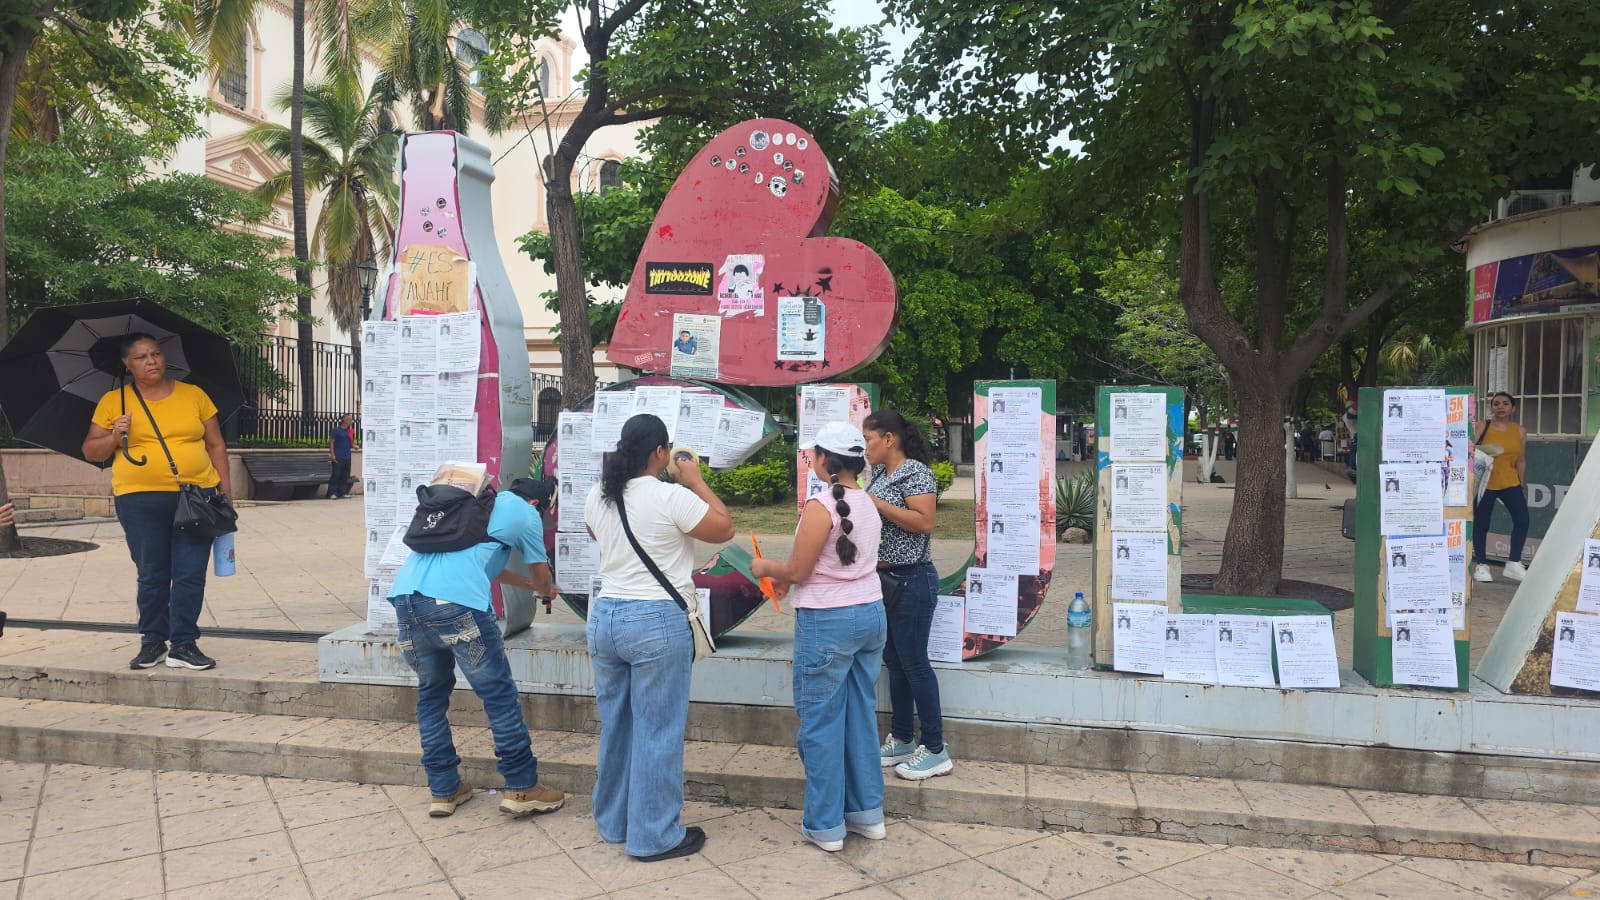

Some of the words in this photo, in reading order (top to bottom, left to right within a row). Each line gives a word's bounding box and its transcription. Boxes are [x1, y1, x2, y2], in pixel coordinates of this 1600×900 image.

[408, 250, 453, 273] #ES
[1449, 396, 1464, 412] 5K
[1448, 520, 1462, 536] 5K
